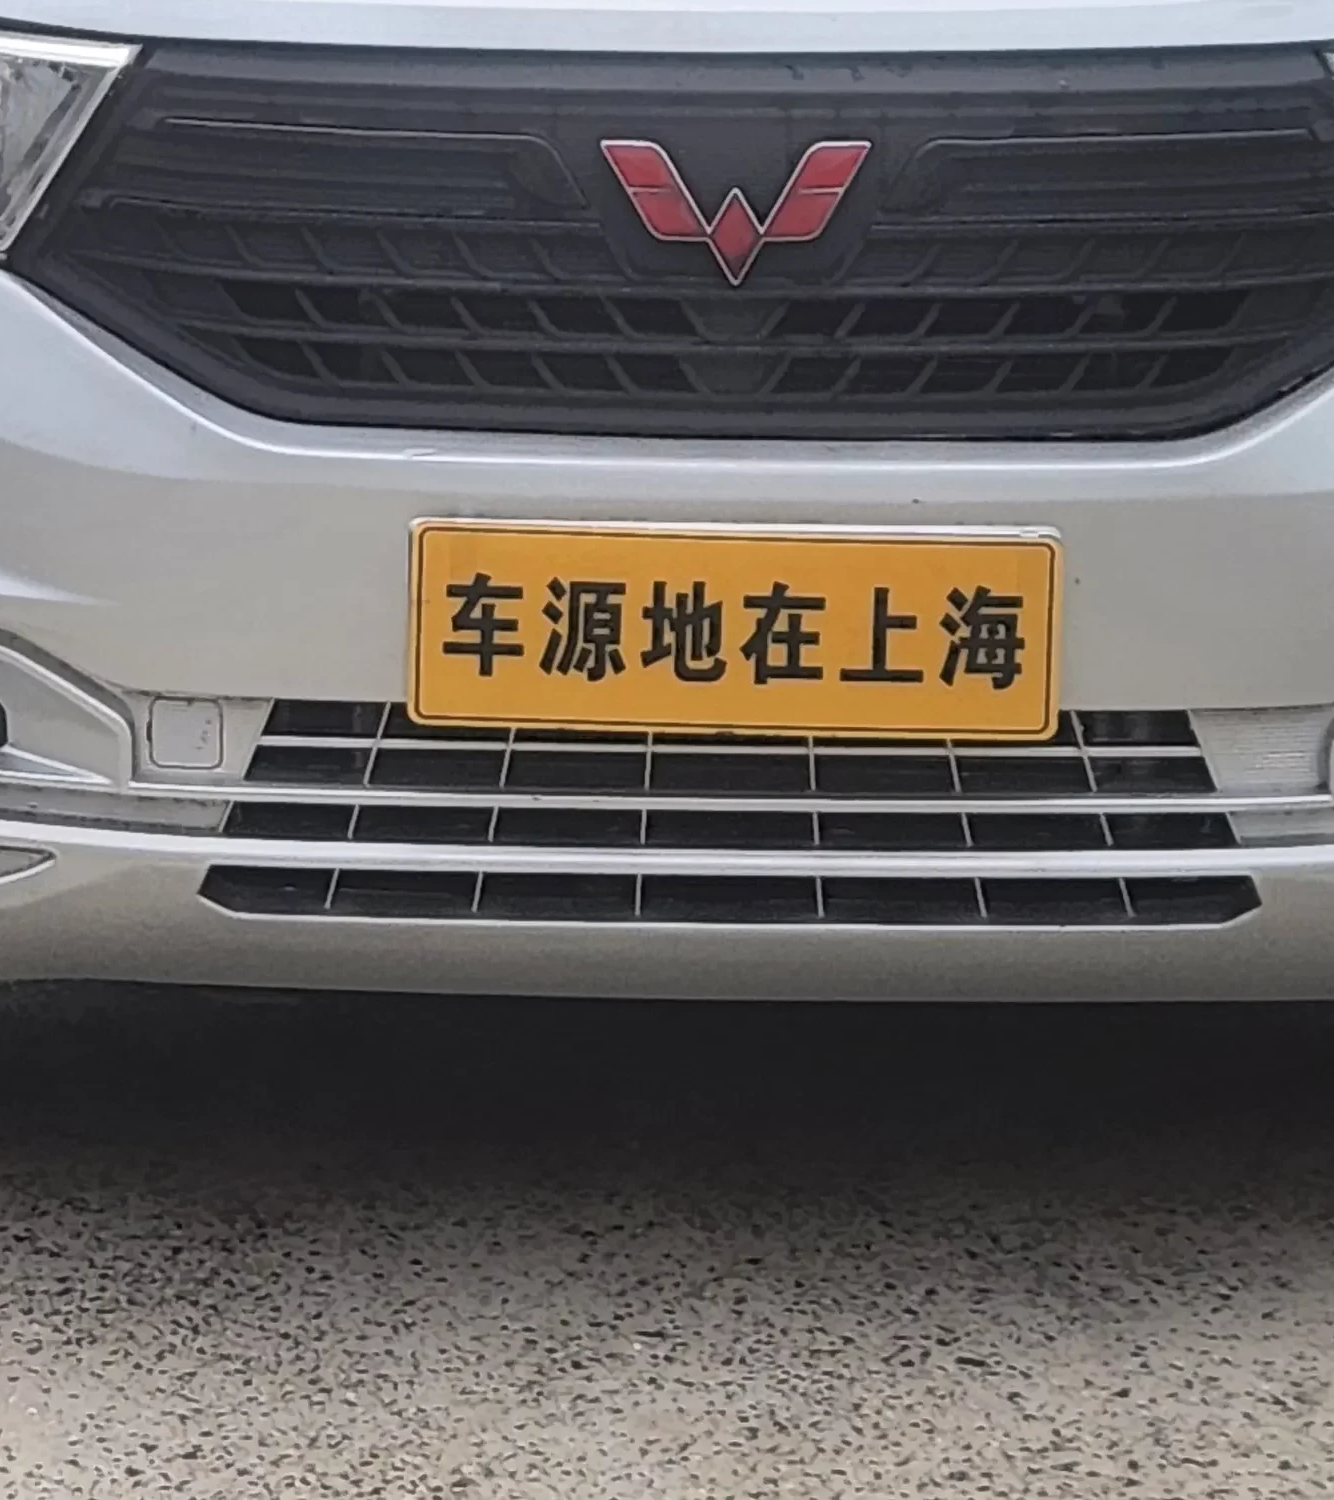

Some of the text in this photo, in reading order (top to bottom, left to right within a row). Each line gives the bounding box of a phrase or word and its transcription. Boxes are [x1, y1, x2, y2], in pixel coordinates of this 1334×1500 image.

[442, 572, 1027, 690] 车源地在上海
